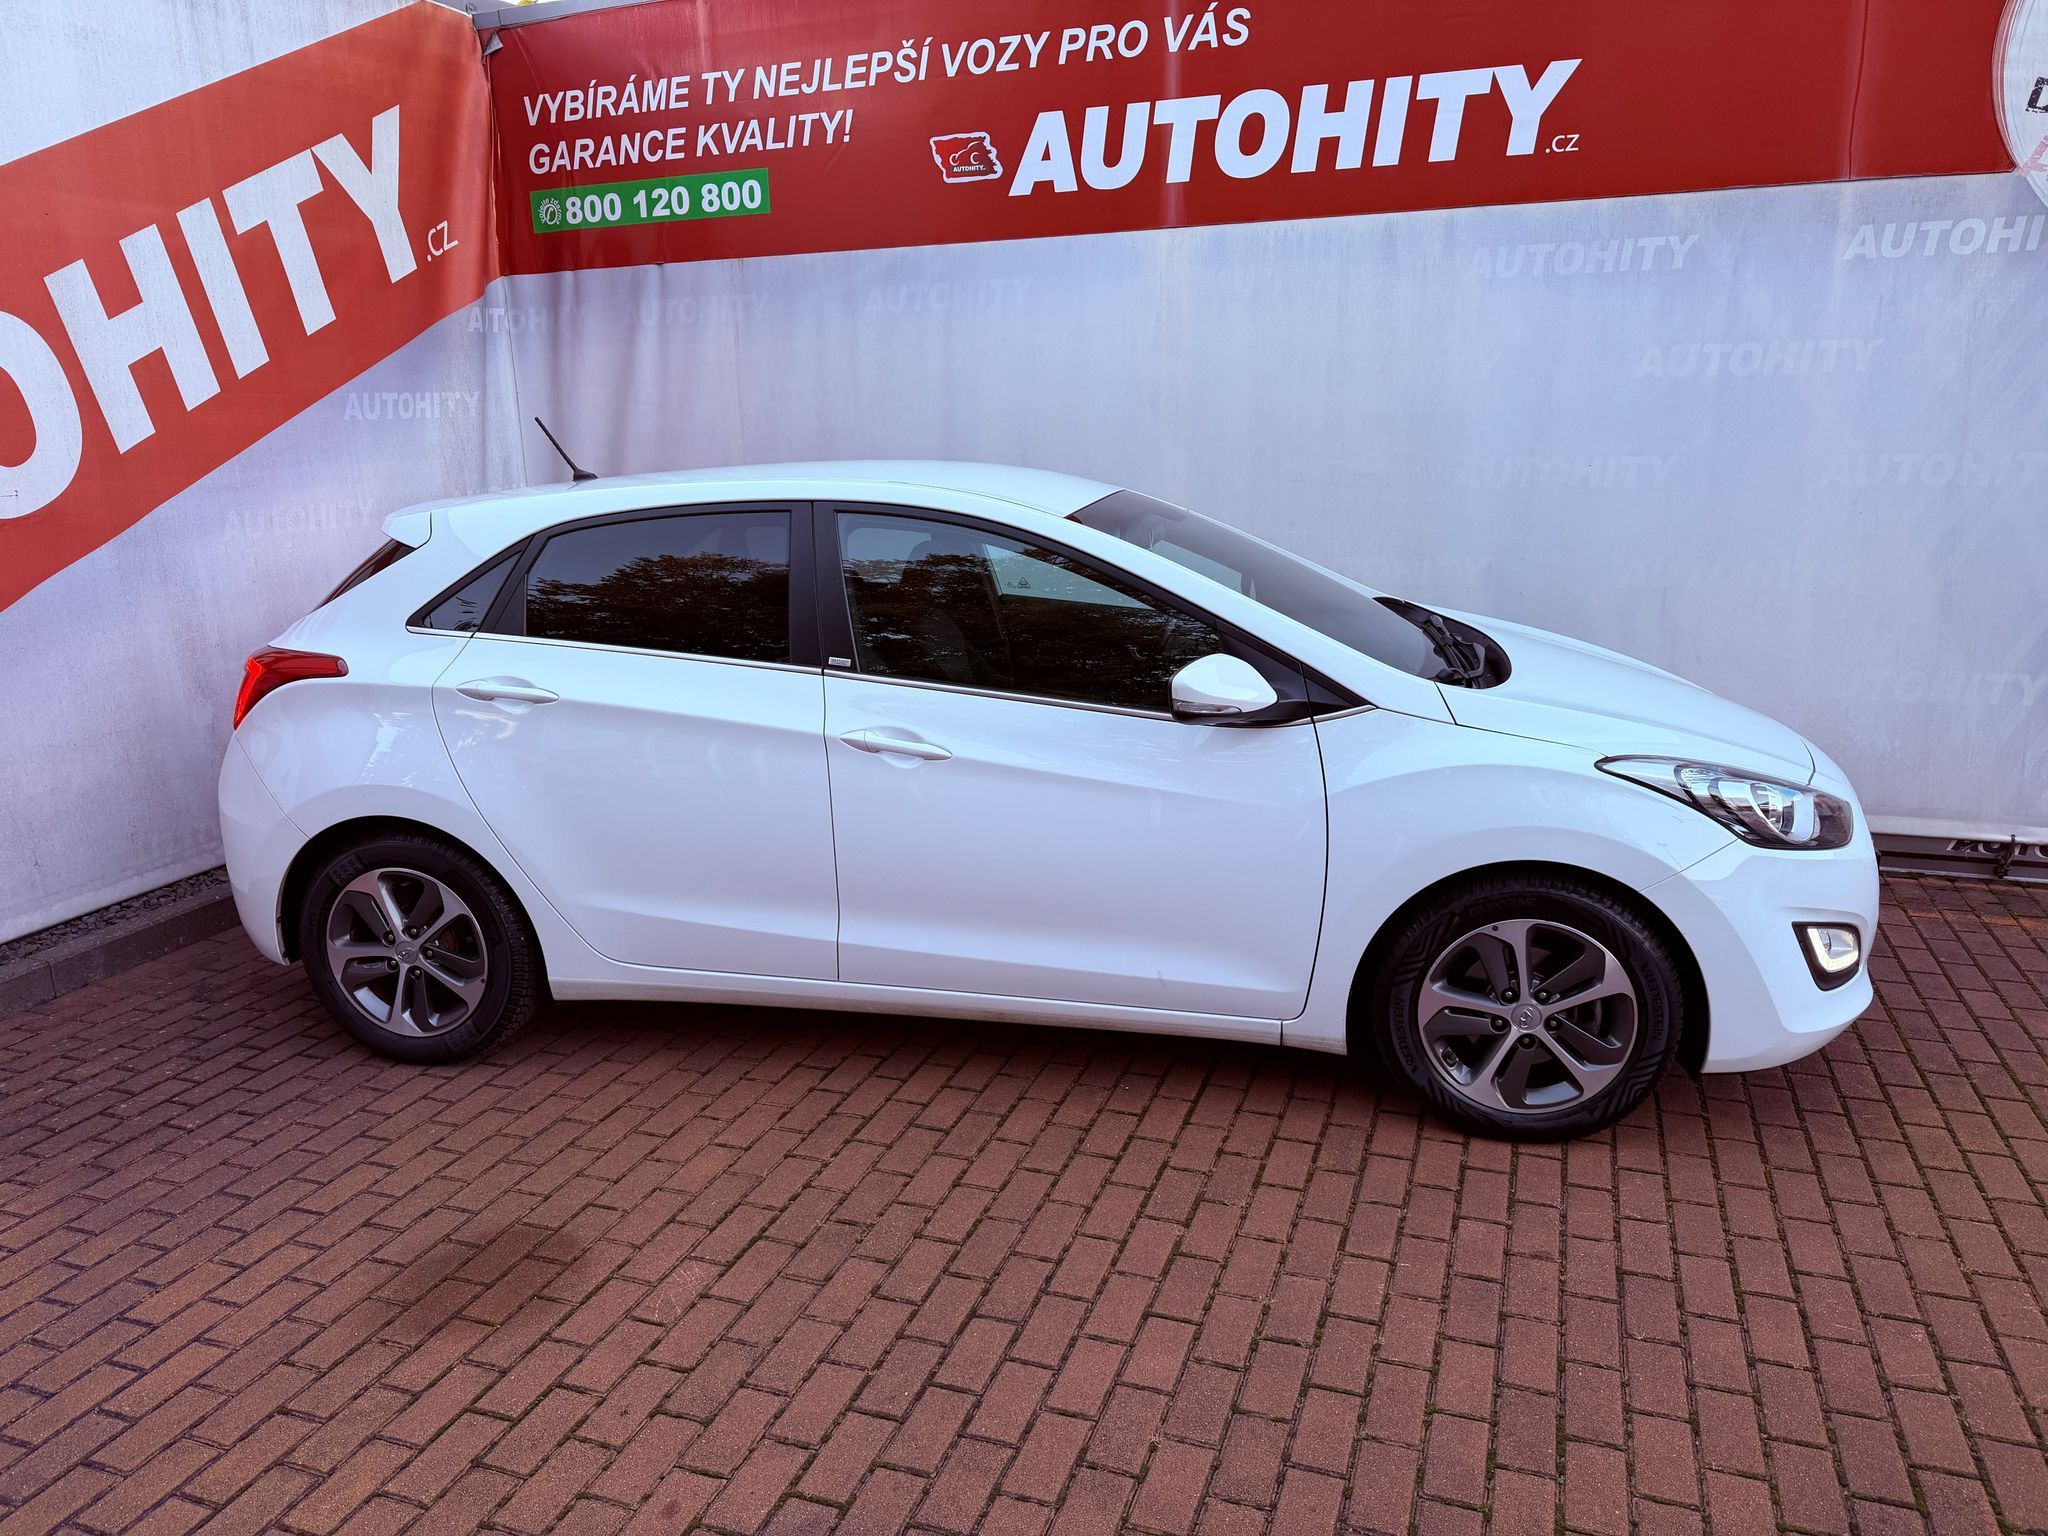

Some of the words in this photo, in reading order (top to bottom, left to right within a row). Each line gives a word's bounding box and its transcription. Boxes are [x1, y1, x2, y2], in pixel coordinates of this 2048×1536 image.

[523, 74, 690, 126] VYBÍRÁME
[702, 68, 745, 104] TY
[752, 37, 934, 99] NEJLEPŠÍ
[942, 31, 1050, 77] VOZY
[1059, 24, 1148, 64] PRO
[1163, 2, 1251, 52] VÁS
[529, 126, 687, 175] GARANCE
[697, 109, 853, 156] KVALITY!
[565, 193, 622, 225] 800
[633, 185, 690, 218] 120
[702, 180, 761, 213] 800
[1470, 233, 1699, 278] AUTOHITY
[1632, 338, 1885, 379] AUTOHITY
[344, 391, 480, 421] AUTOHITY
